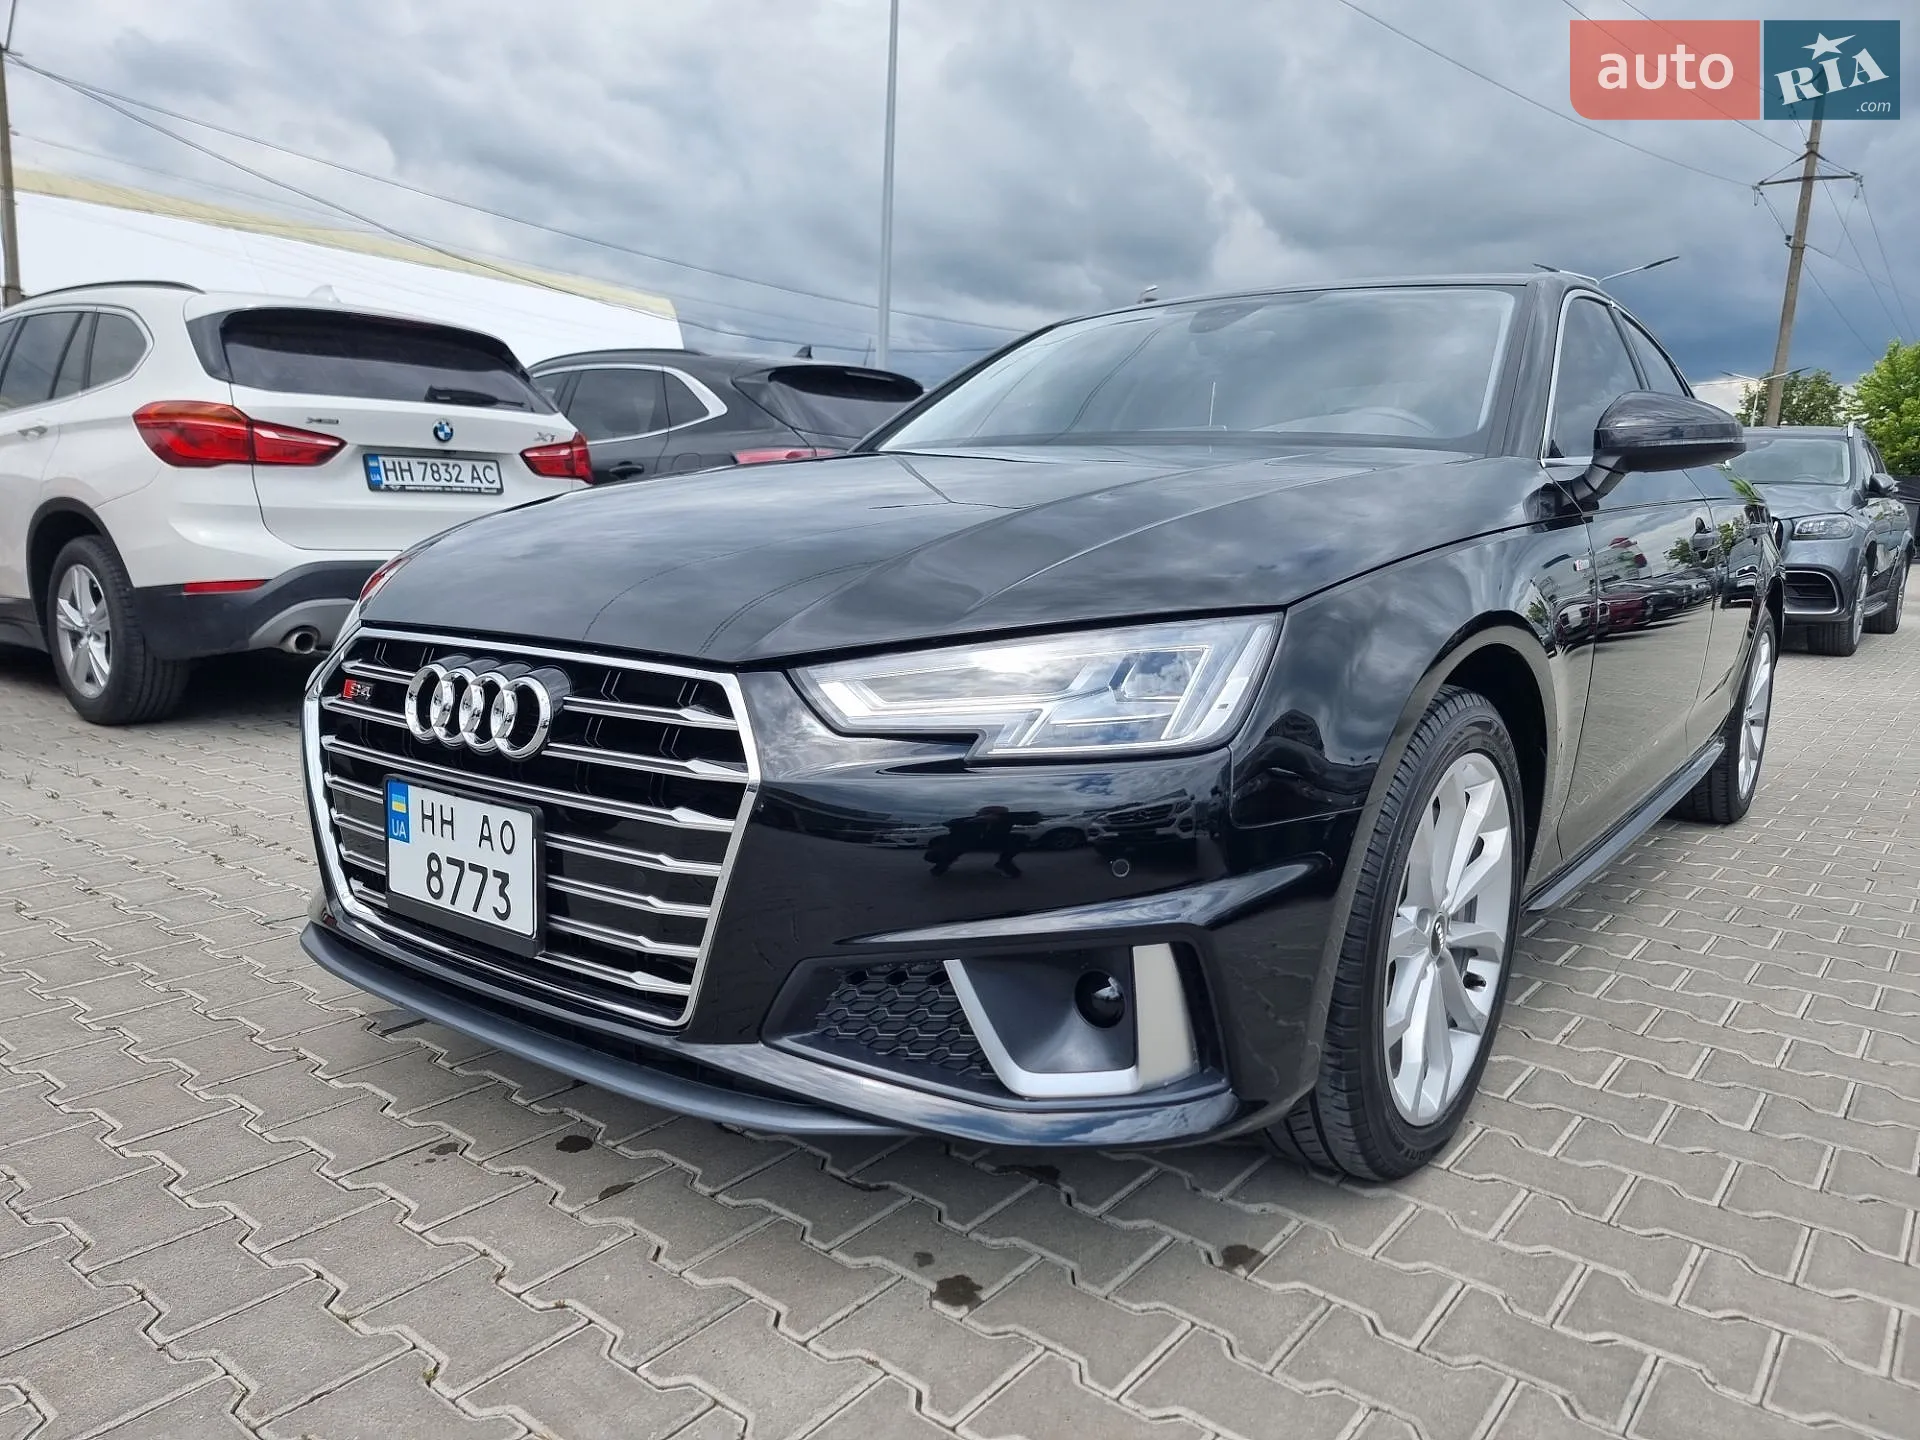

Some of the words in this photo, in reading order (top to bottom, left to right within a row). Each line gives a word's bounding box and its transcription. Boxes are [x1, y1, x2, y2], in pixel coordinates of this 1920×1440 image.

[382, 460, 414, 482] HH
[417, 461, 465, 483] 7832
[471, 464, 496, 484] AC
[391, 818, 407, 839] UA
[421, 799, 455, 841] HH
[478, 814, 516, 855] AO
[425, 852, 512, 921] 8773
